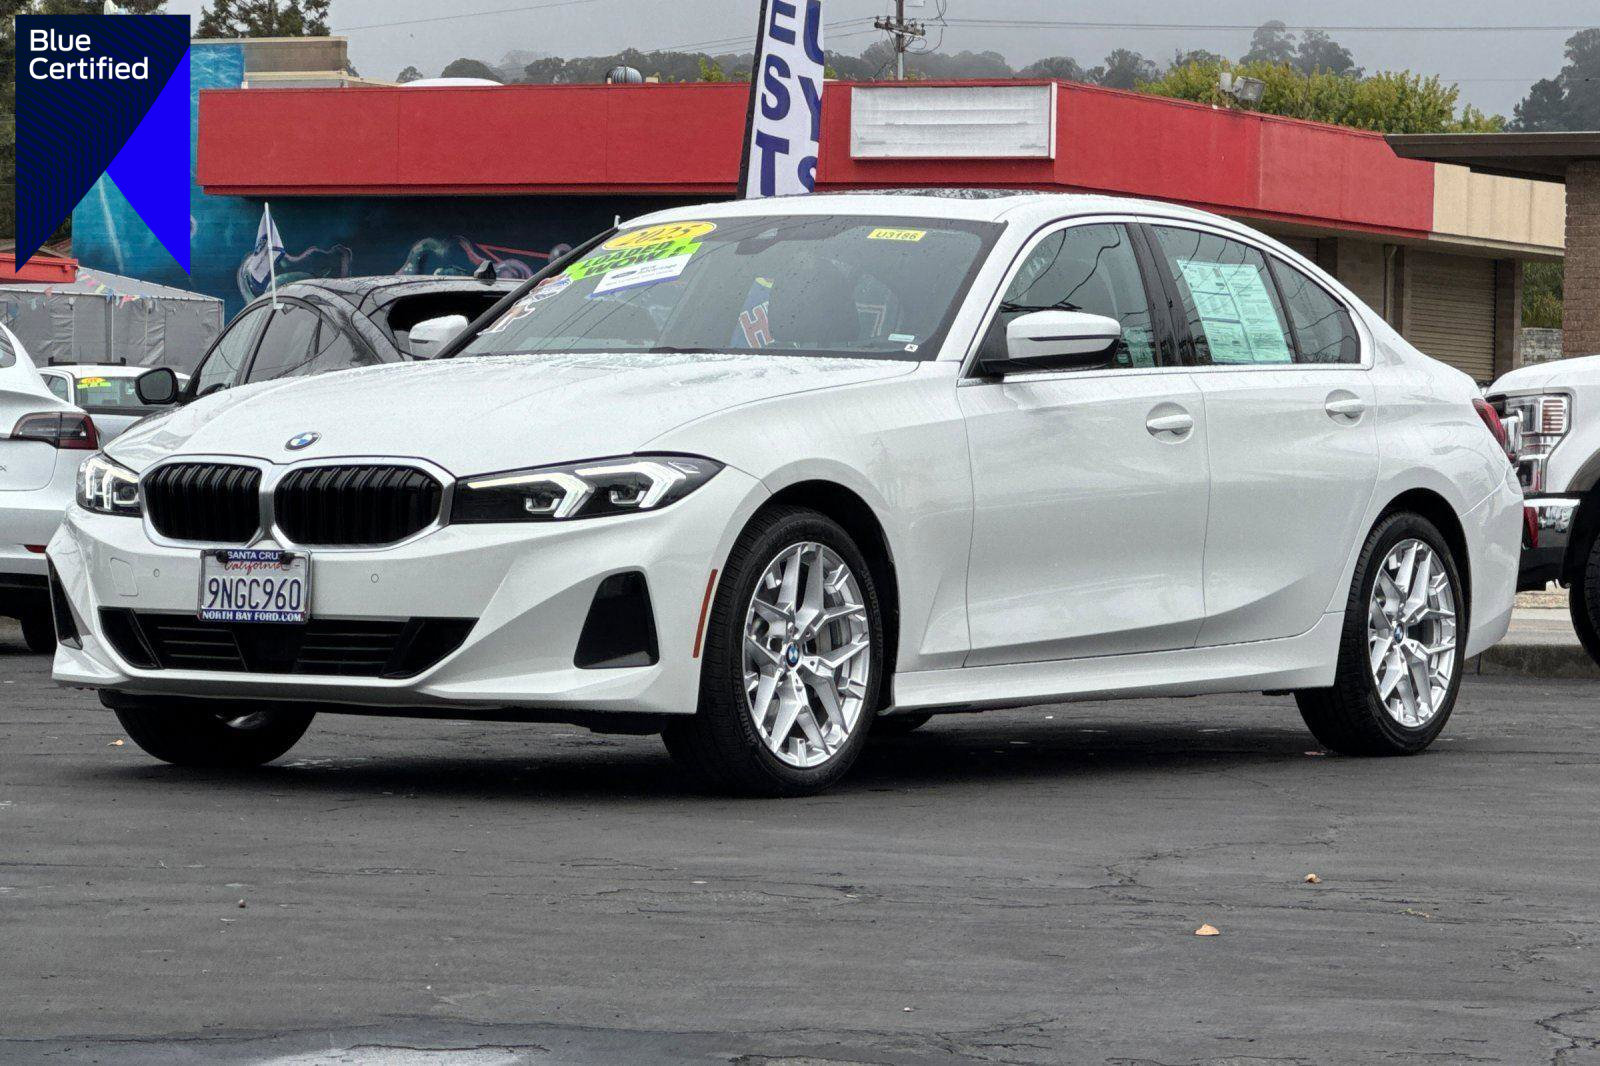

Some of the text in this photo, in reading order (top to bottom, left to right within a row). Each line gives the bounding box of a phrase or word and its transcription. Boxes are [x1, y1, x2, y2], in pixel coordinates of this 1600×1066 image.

[580, 240, 675, 269] LOADED
[228, 551, 282, 560] SANTA CRU
[225, 561, 290, 575] California
[208, 577, 301, 611] 9NGC960
[202, 610, 234, 620] NORTH
[235, 611, 252, 620] BAY
